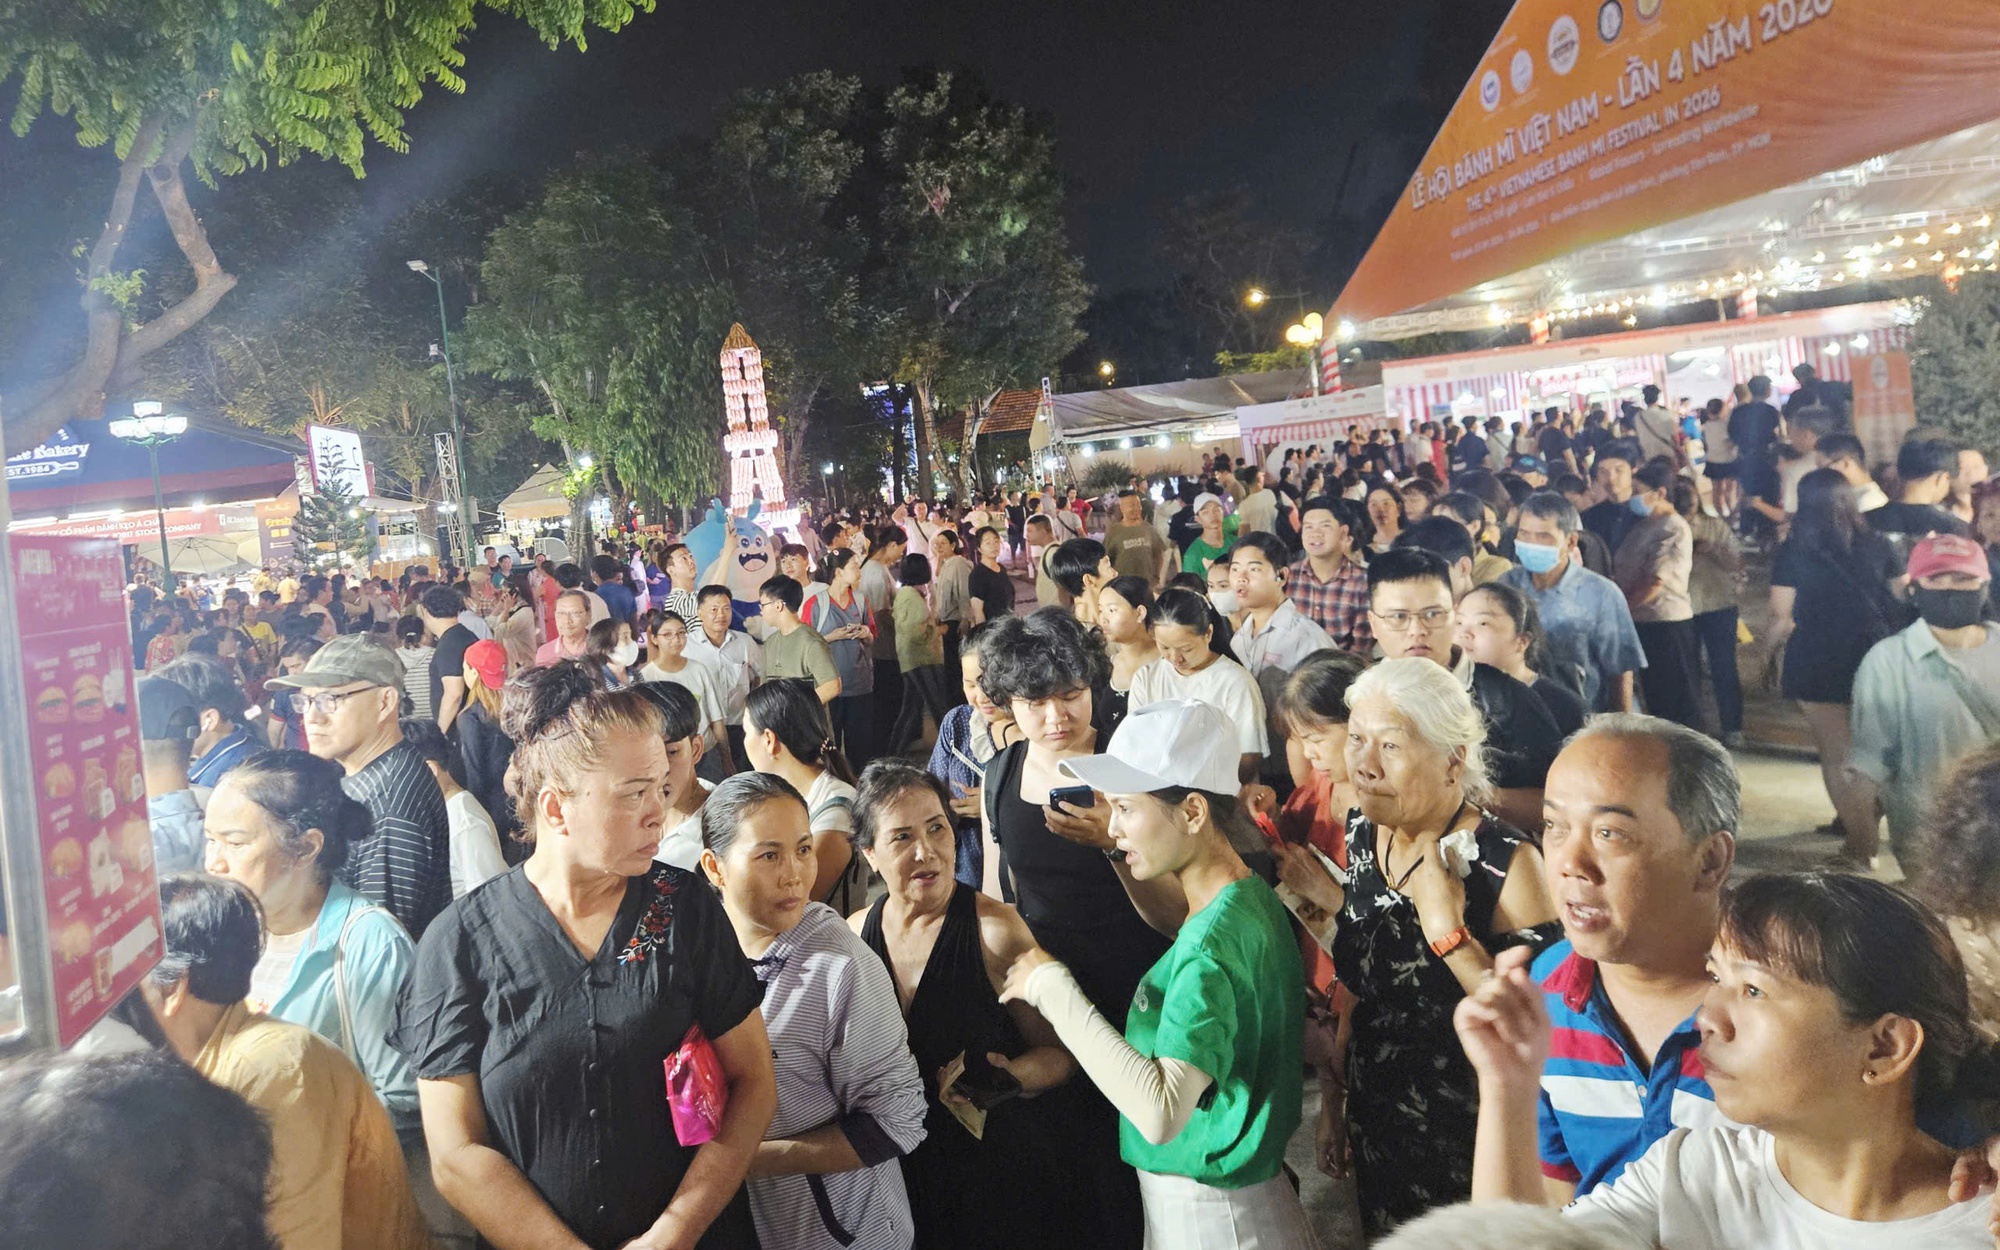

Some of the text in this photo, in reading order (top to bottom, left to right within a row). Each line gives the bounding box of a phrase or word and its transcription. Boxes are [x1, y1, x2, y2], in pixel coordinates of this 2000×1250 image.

[1411, 172, 1425, 209] LỄ
[1428, 165, 1452, 201] HỘI
[1455, 145, 1494, 188] BÁNH
[1497, 128, 1515, 167] MÌ
[1518, 113, 1551, 155] VIỆT
[1556, 90, 1599, 138] NAM
[1618, 56, 1661, 109] LẦN
[1668, 48, 1683, 81] 4
[1691, 16, 1751, 73] NĂM
[1500, 158, 1557, 198] VIETNAMESE
[1557, 142, 1589, 173] BANH
[1607, 112, 1662, 149] FESTIVAL
[1664, 103, 1679, 127] IN
[1683, 85, 1721, 119] 2026
[33, 443, 90, 459] Bakery
[164, 523, 202, 534] COMPANY
